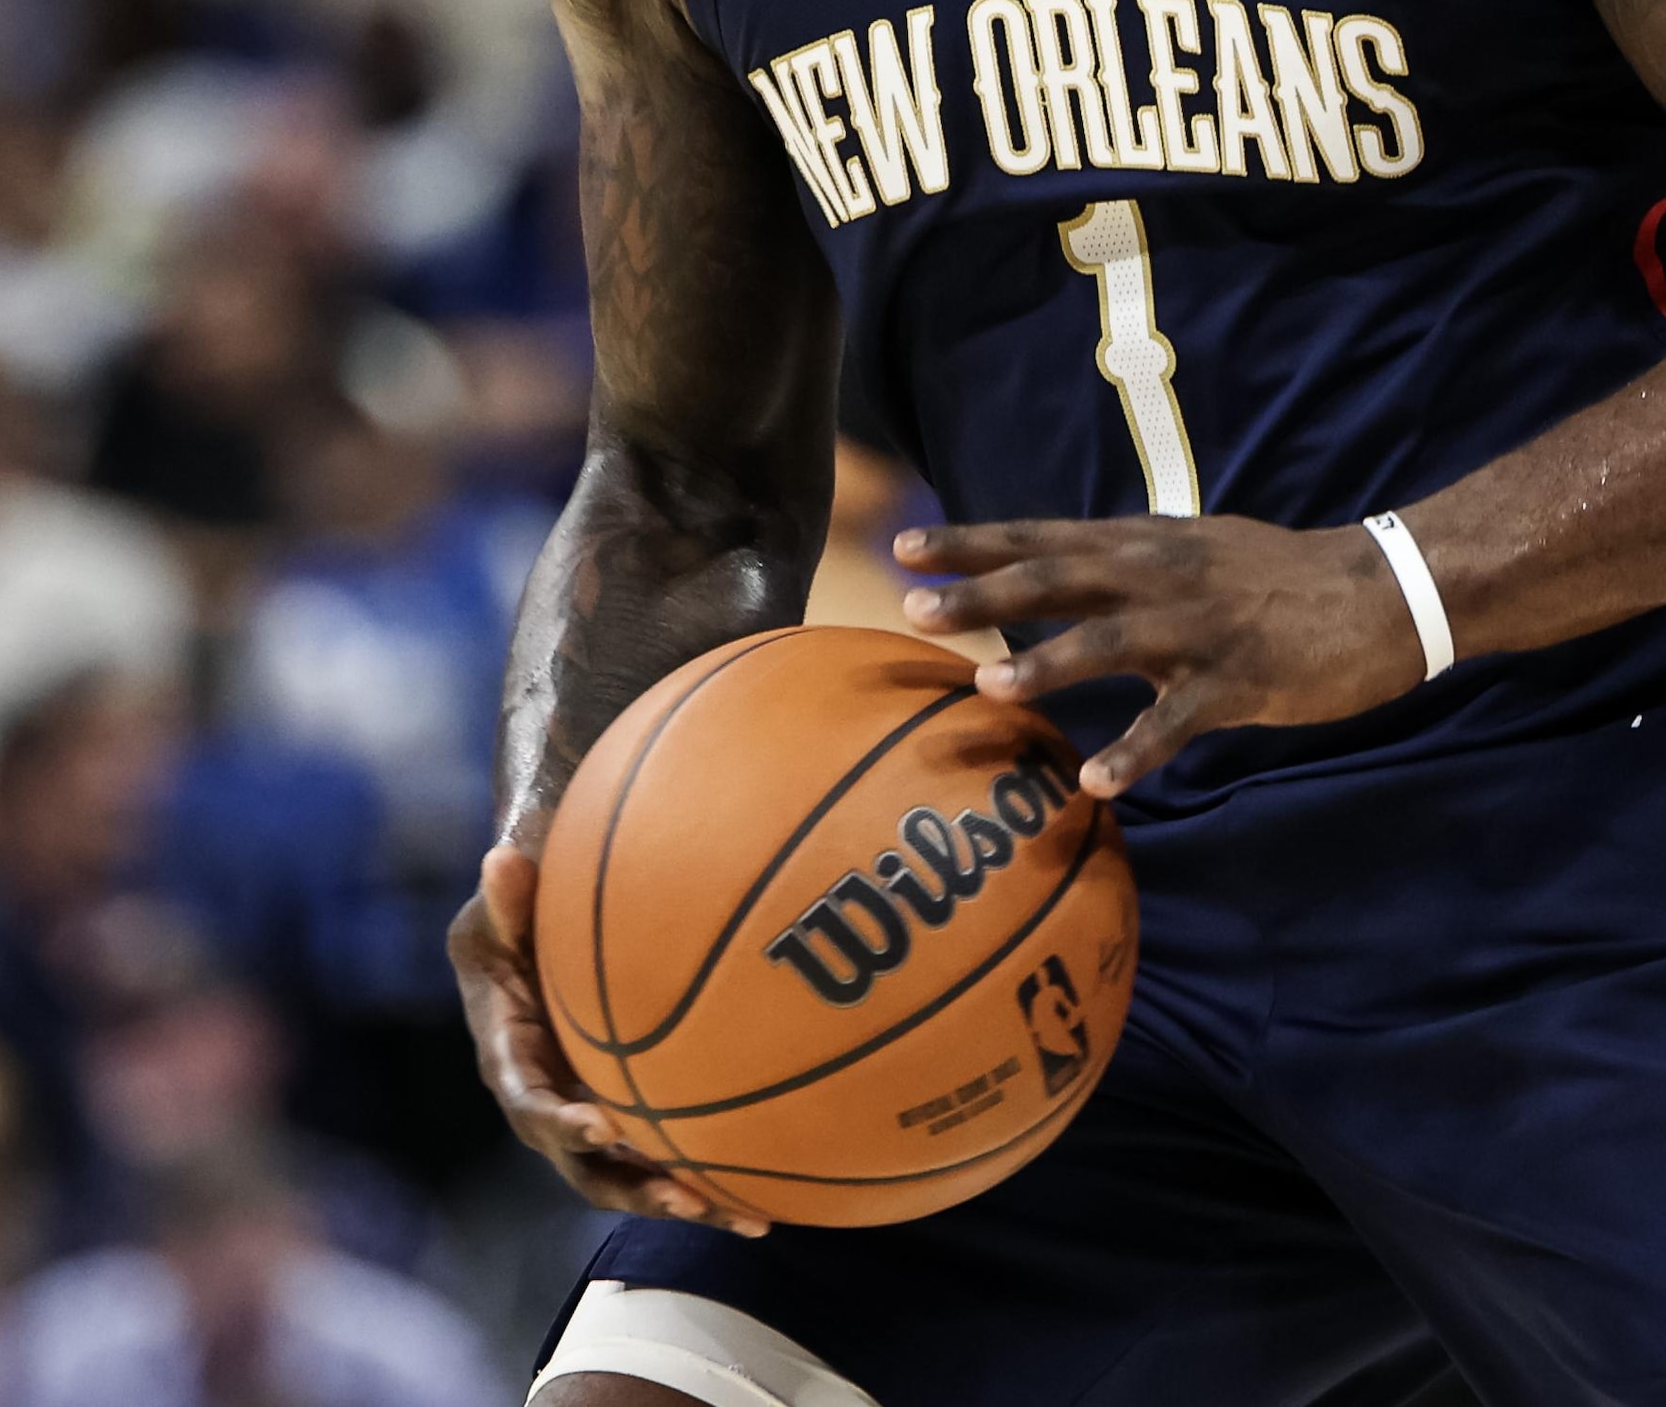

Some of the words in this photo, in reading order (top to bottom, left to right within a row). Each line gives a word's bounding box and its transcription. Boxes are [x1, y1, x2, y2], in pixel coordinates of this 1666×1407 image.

[748, 5, 951, 228] NEW
[1057, 199, 1200, 518] 1
[763, 742, 1081, 1009] Wilson
